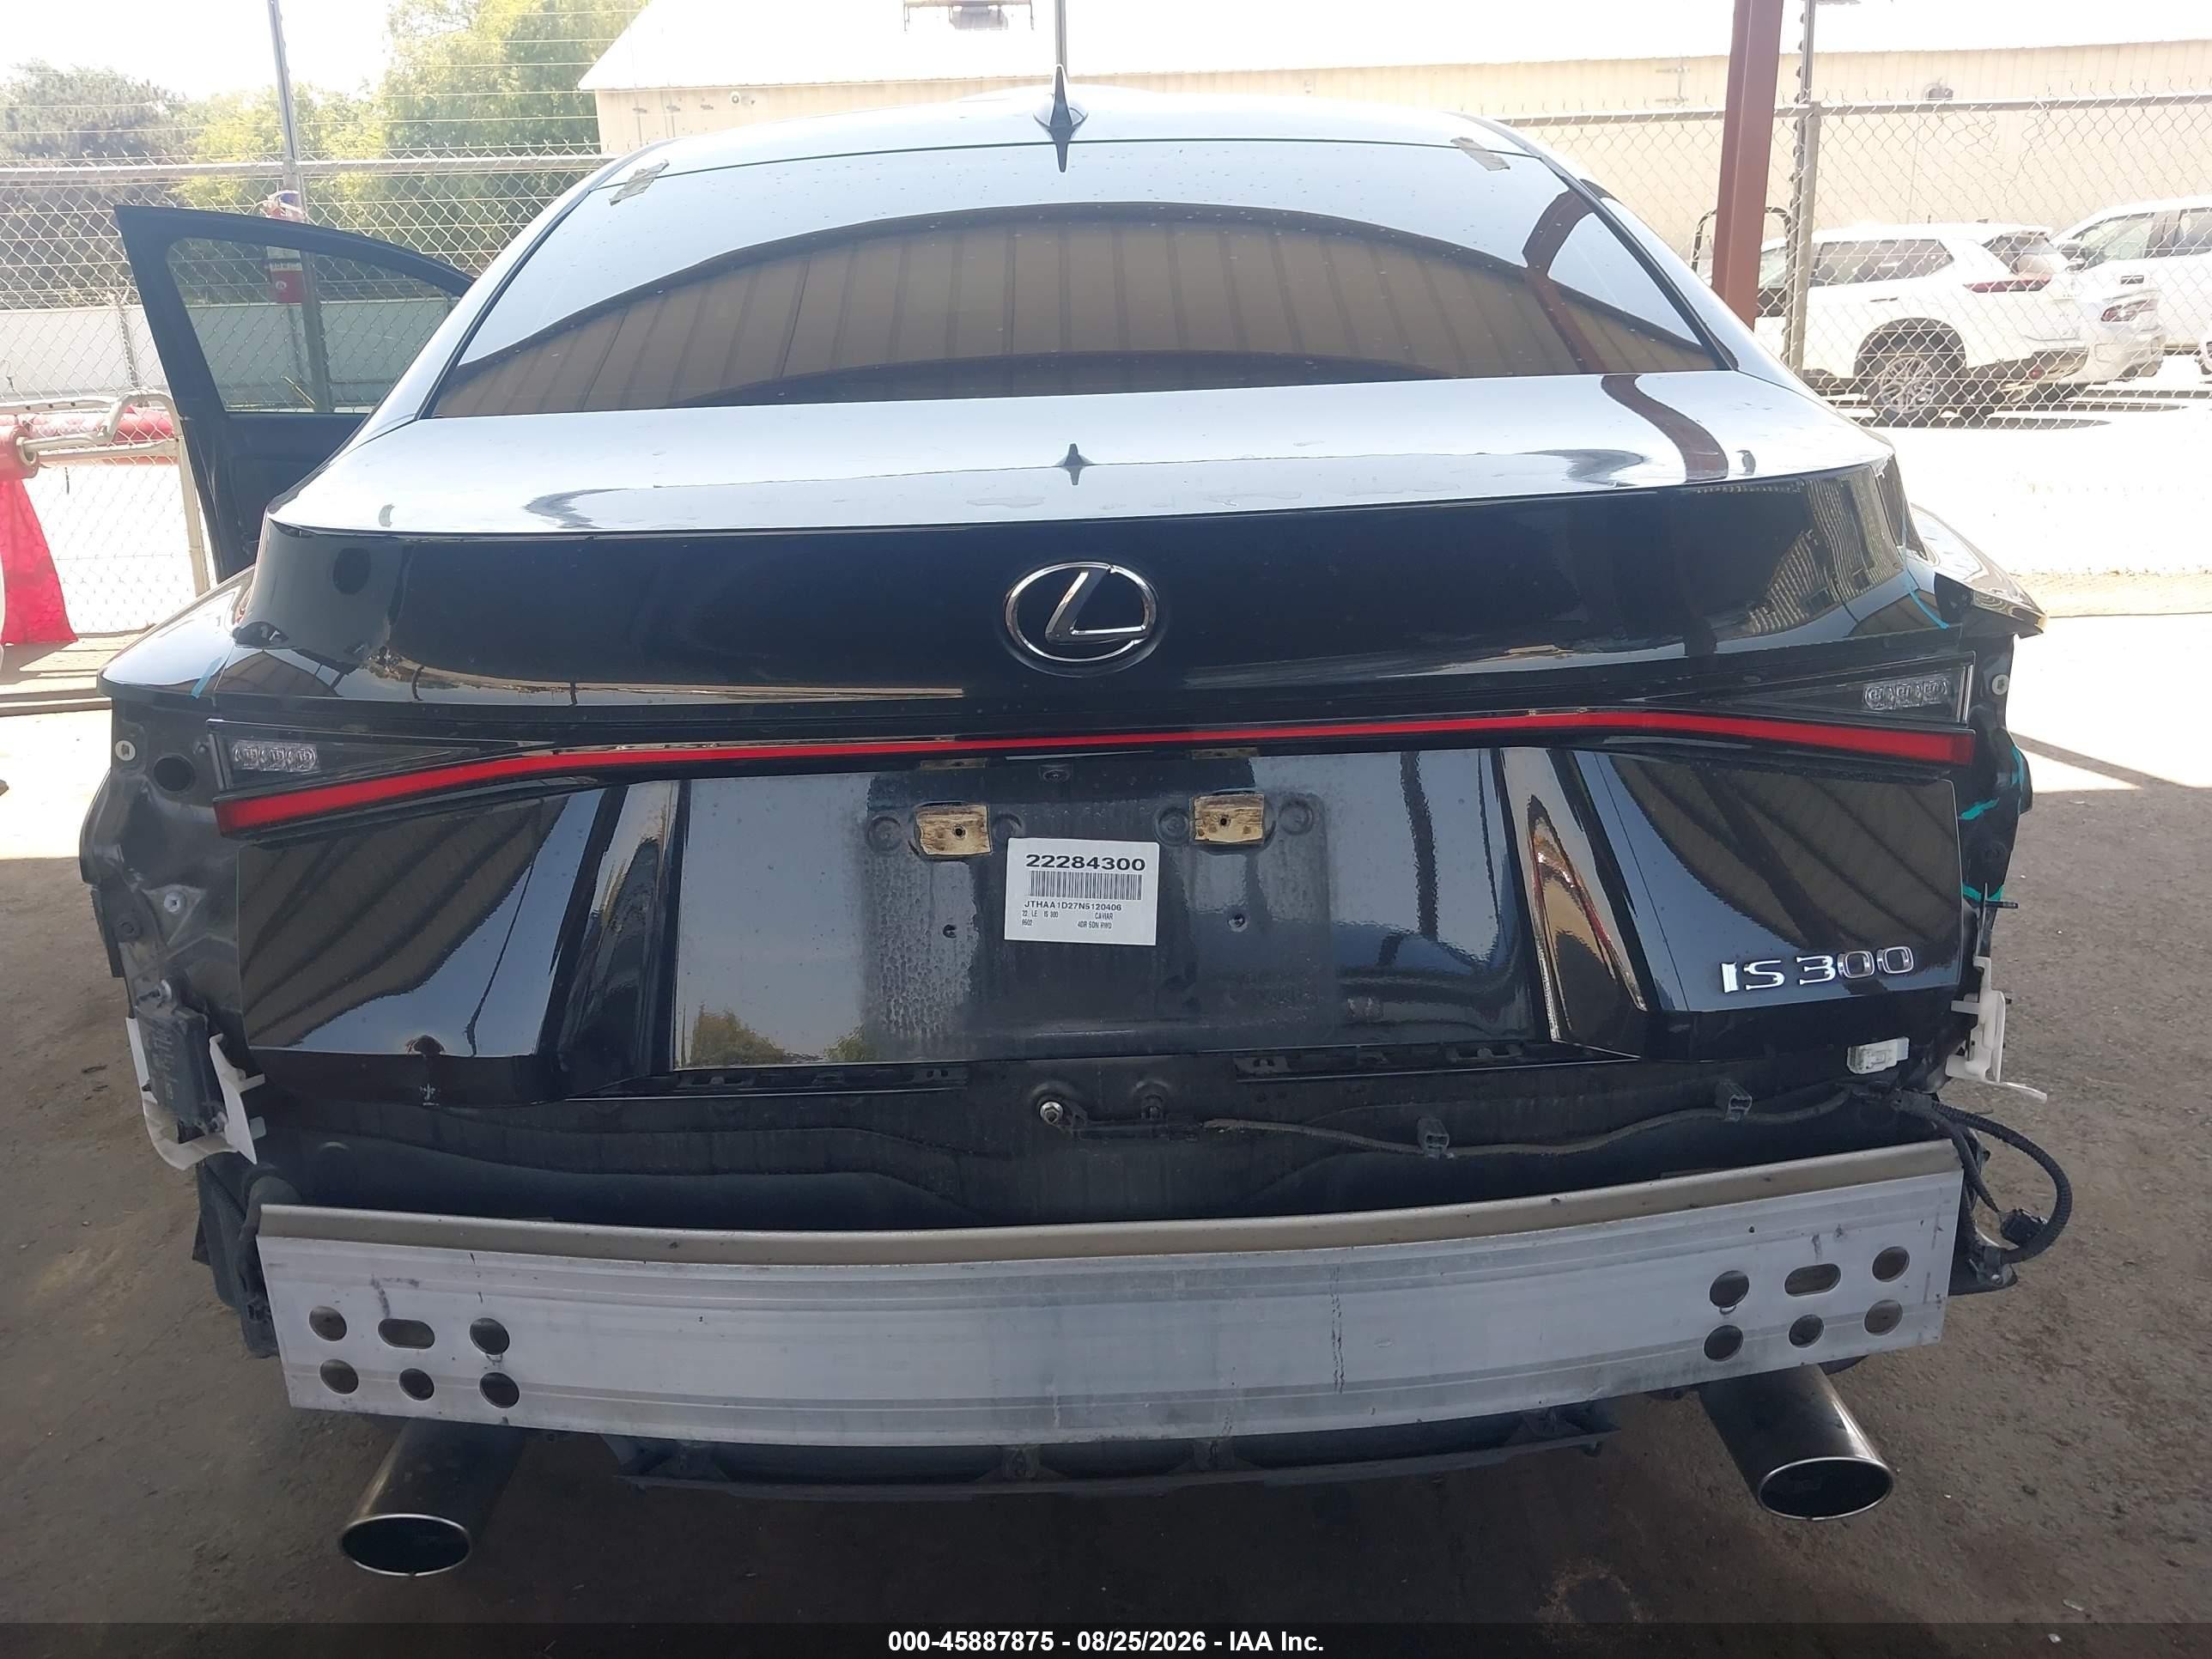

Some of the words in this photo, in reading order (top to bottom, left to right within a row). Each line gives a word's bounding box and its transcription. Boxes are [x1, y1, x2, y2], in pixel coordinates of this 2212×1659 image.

[1025, 854, 1146, 872] 22284300
[1024, 900, 1122, 911] JTHAA1D27N5120406
[1094, 912, 1114, 921] CAVIAR
[1720, 958, 1786, 994] IS
[1795, 945, 1914, 987] 300
